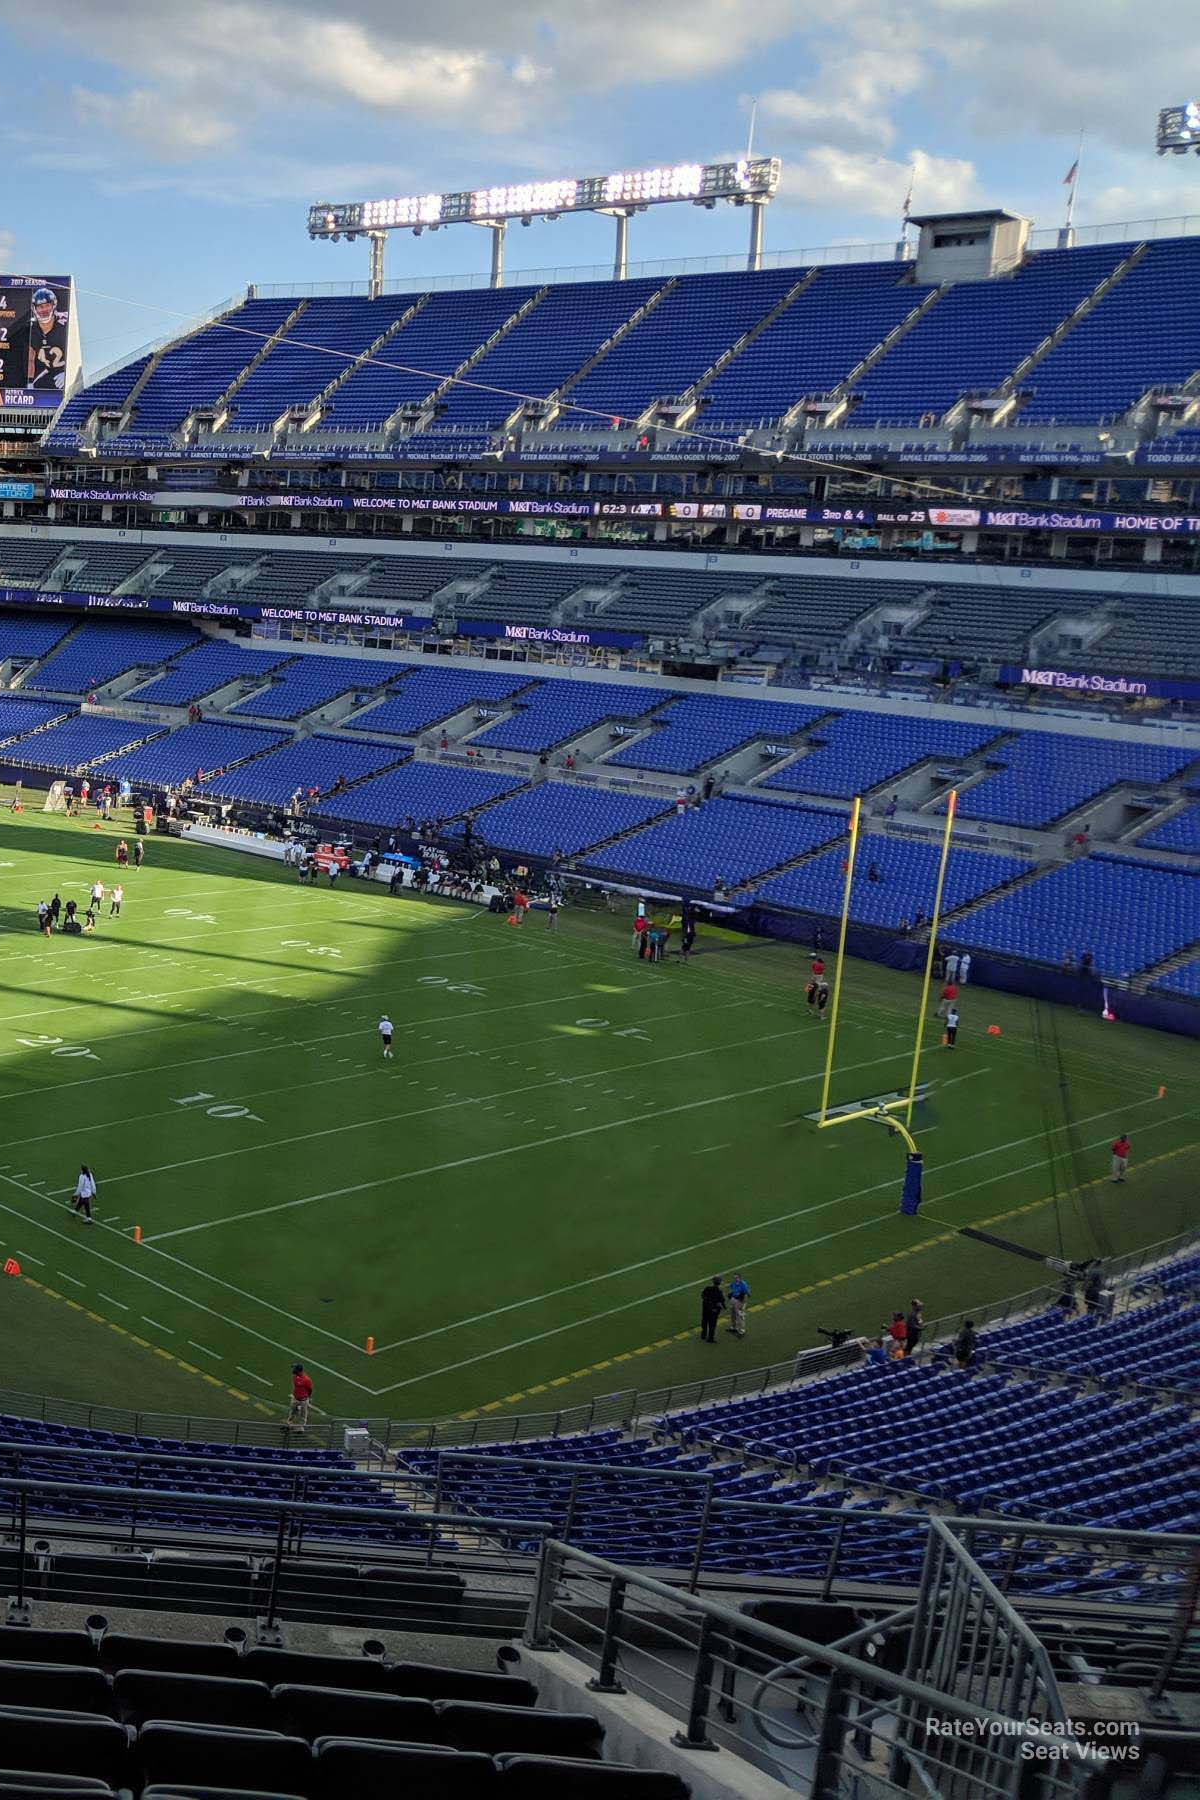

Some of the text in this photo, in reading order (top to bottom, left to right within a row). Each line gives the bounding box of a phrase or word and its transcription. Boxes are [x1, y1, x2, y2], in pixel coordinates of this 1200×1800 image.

[0, 296, 7, 309] 4
[5, 395, 34, 405] RICARD
[50, 488, 70, 499] M&T
[70, 489, 90, 499] Bank
[247, 496, 265, 506] Bank
[294, 496, 312, 506] Bank
[312, 497, 343, 507] Stadium
[353, 498, 498, 511] WELCOME TO M&T BANK STADIUM
[509, 501, 590, 514] M&T Bank Stadium
[683, 505, 690, 516] 0
[747, 507, 754, 518] 0
[766, 508, 808, 519] PREGAME
[822, 509, 865, 520] 3RD & 4
[877, 513, 896, 521] BALL
[910, 511, 925, 522] 25
[987, 512, 1019, 525] M&T
[1018, 513, 1049, 527] Bank
[1050, 514, 1101, 528] Stadium
[1115, 516, 1159, 529] HOME
[1162, 517, 1183, 530] OF
[172, 601, 239, 615] M&T Bank Stadium
[261, 609, 403, 627] WELCOME TO M&T BANK STADIUM
[505, 626, 590, 643] M&T Bank Stadium
[1021, 669, 1147, 694] M&T Bank Stadium
[16, 1034, 91, 1057] 20
[169, 1092, 249, 1119] 10
